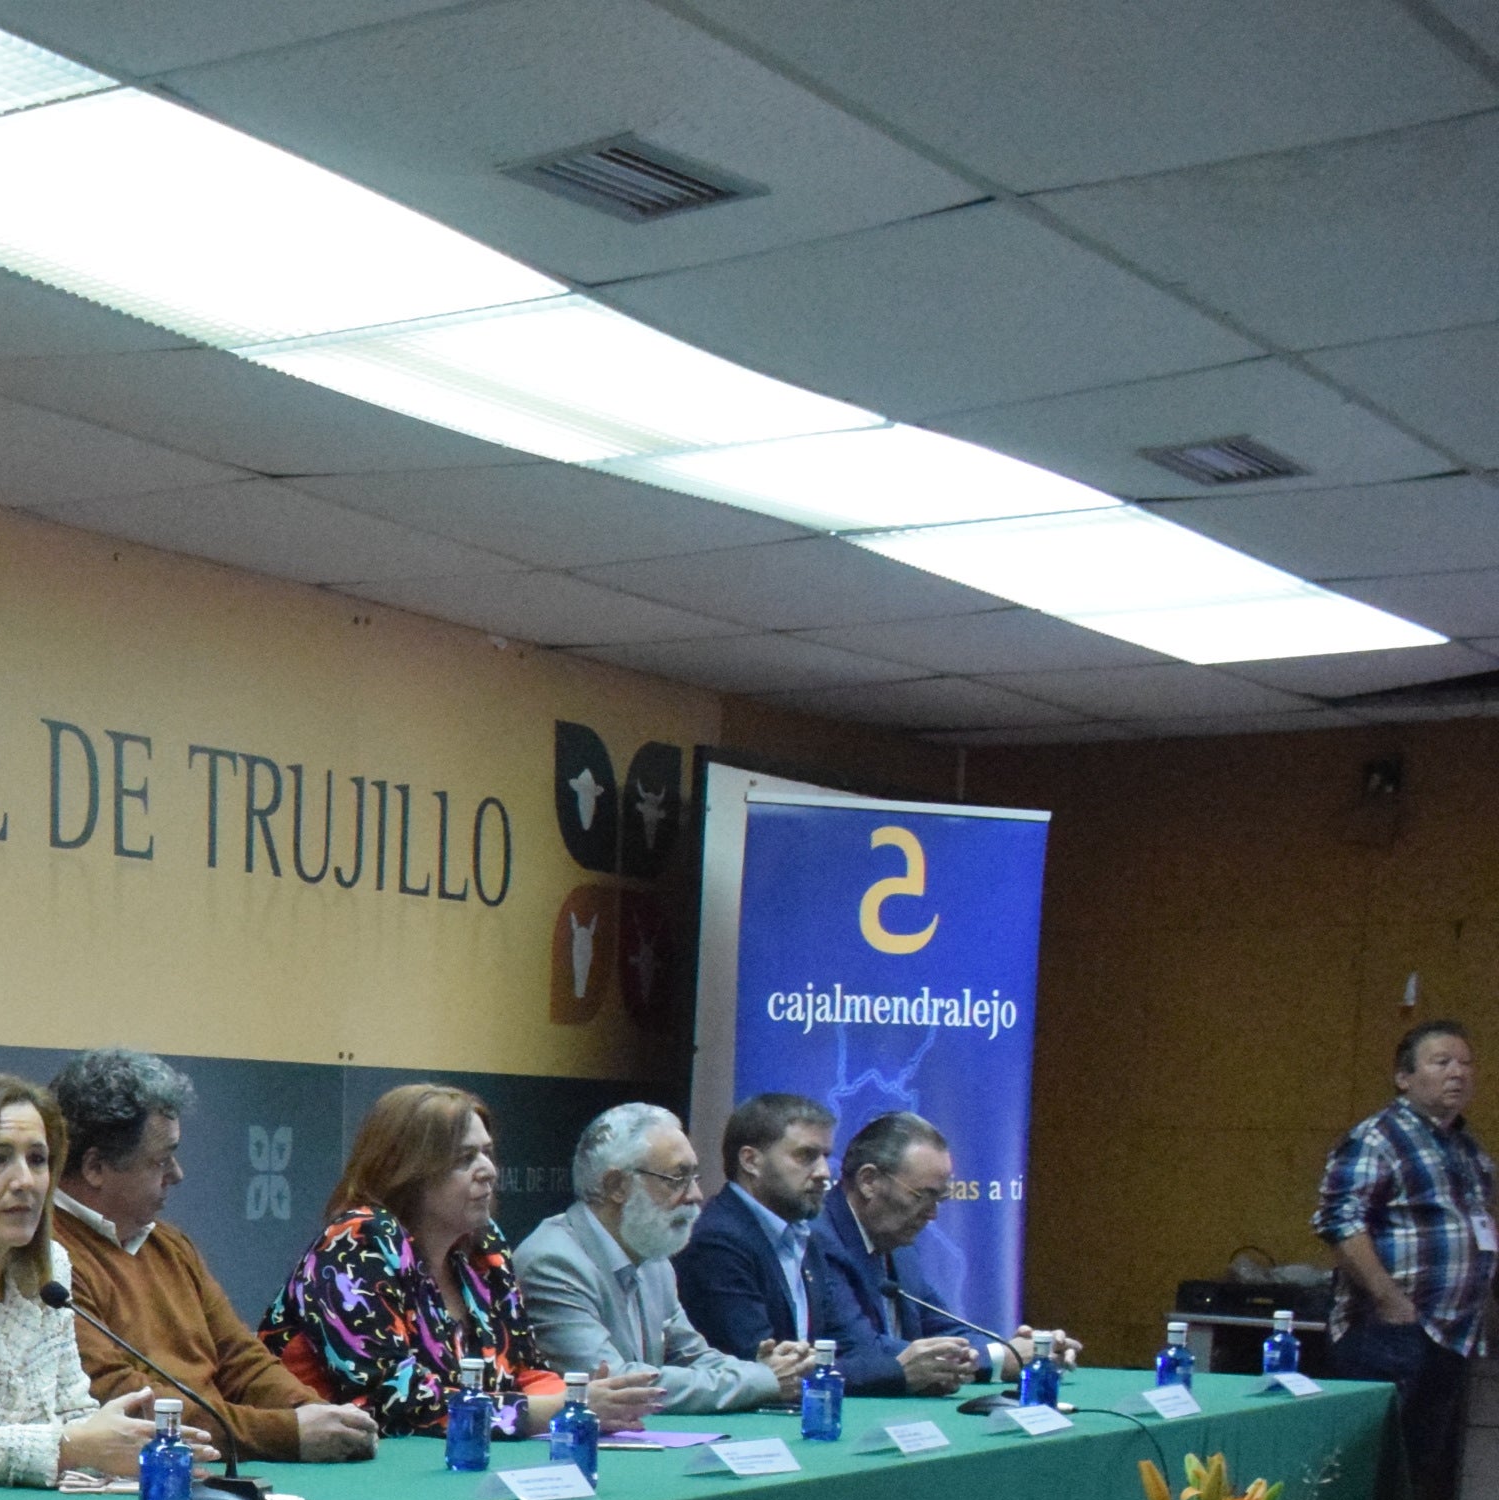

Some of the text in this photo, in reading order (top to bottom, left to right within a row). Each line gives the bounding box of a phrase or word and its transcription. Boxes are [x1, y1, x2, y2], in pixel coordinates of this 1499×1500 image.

[40, 718, 155, 861] DE
[188, 745, 512, 907] TRUJILLO
[767, 982, 1017, 1041] cajalmendralejo
